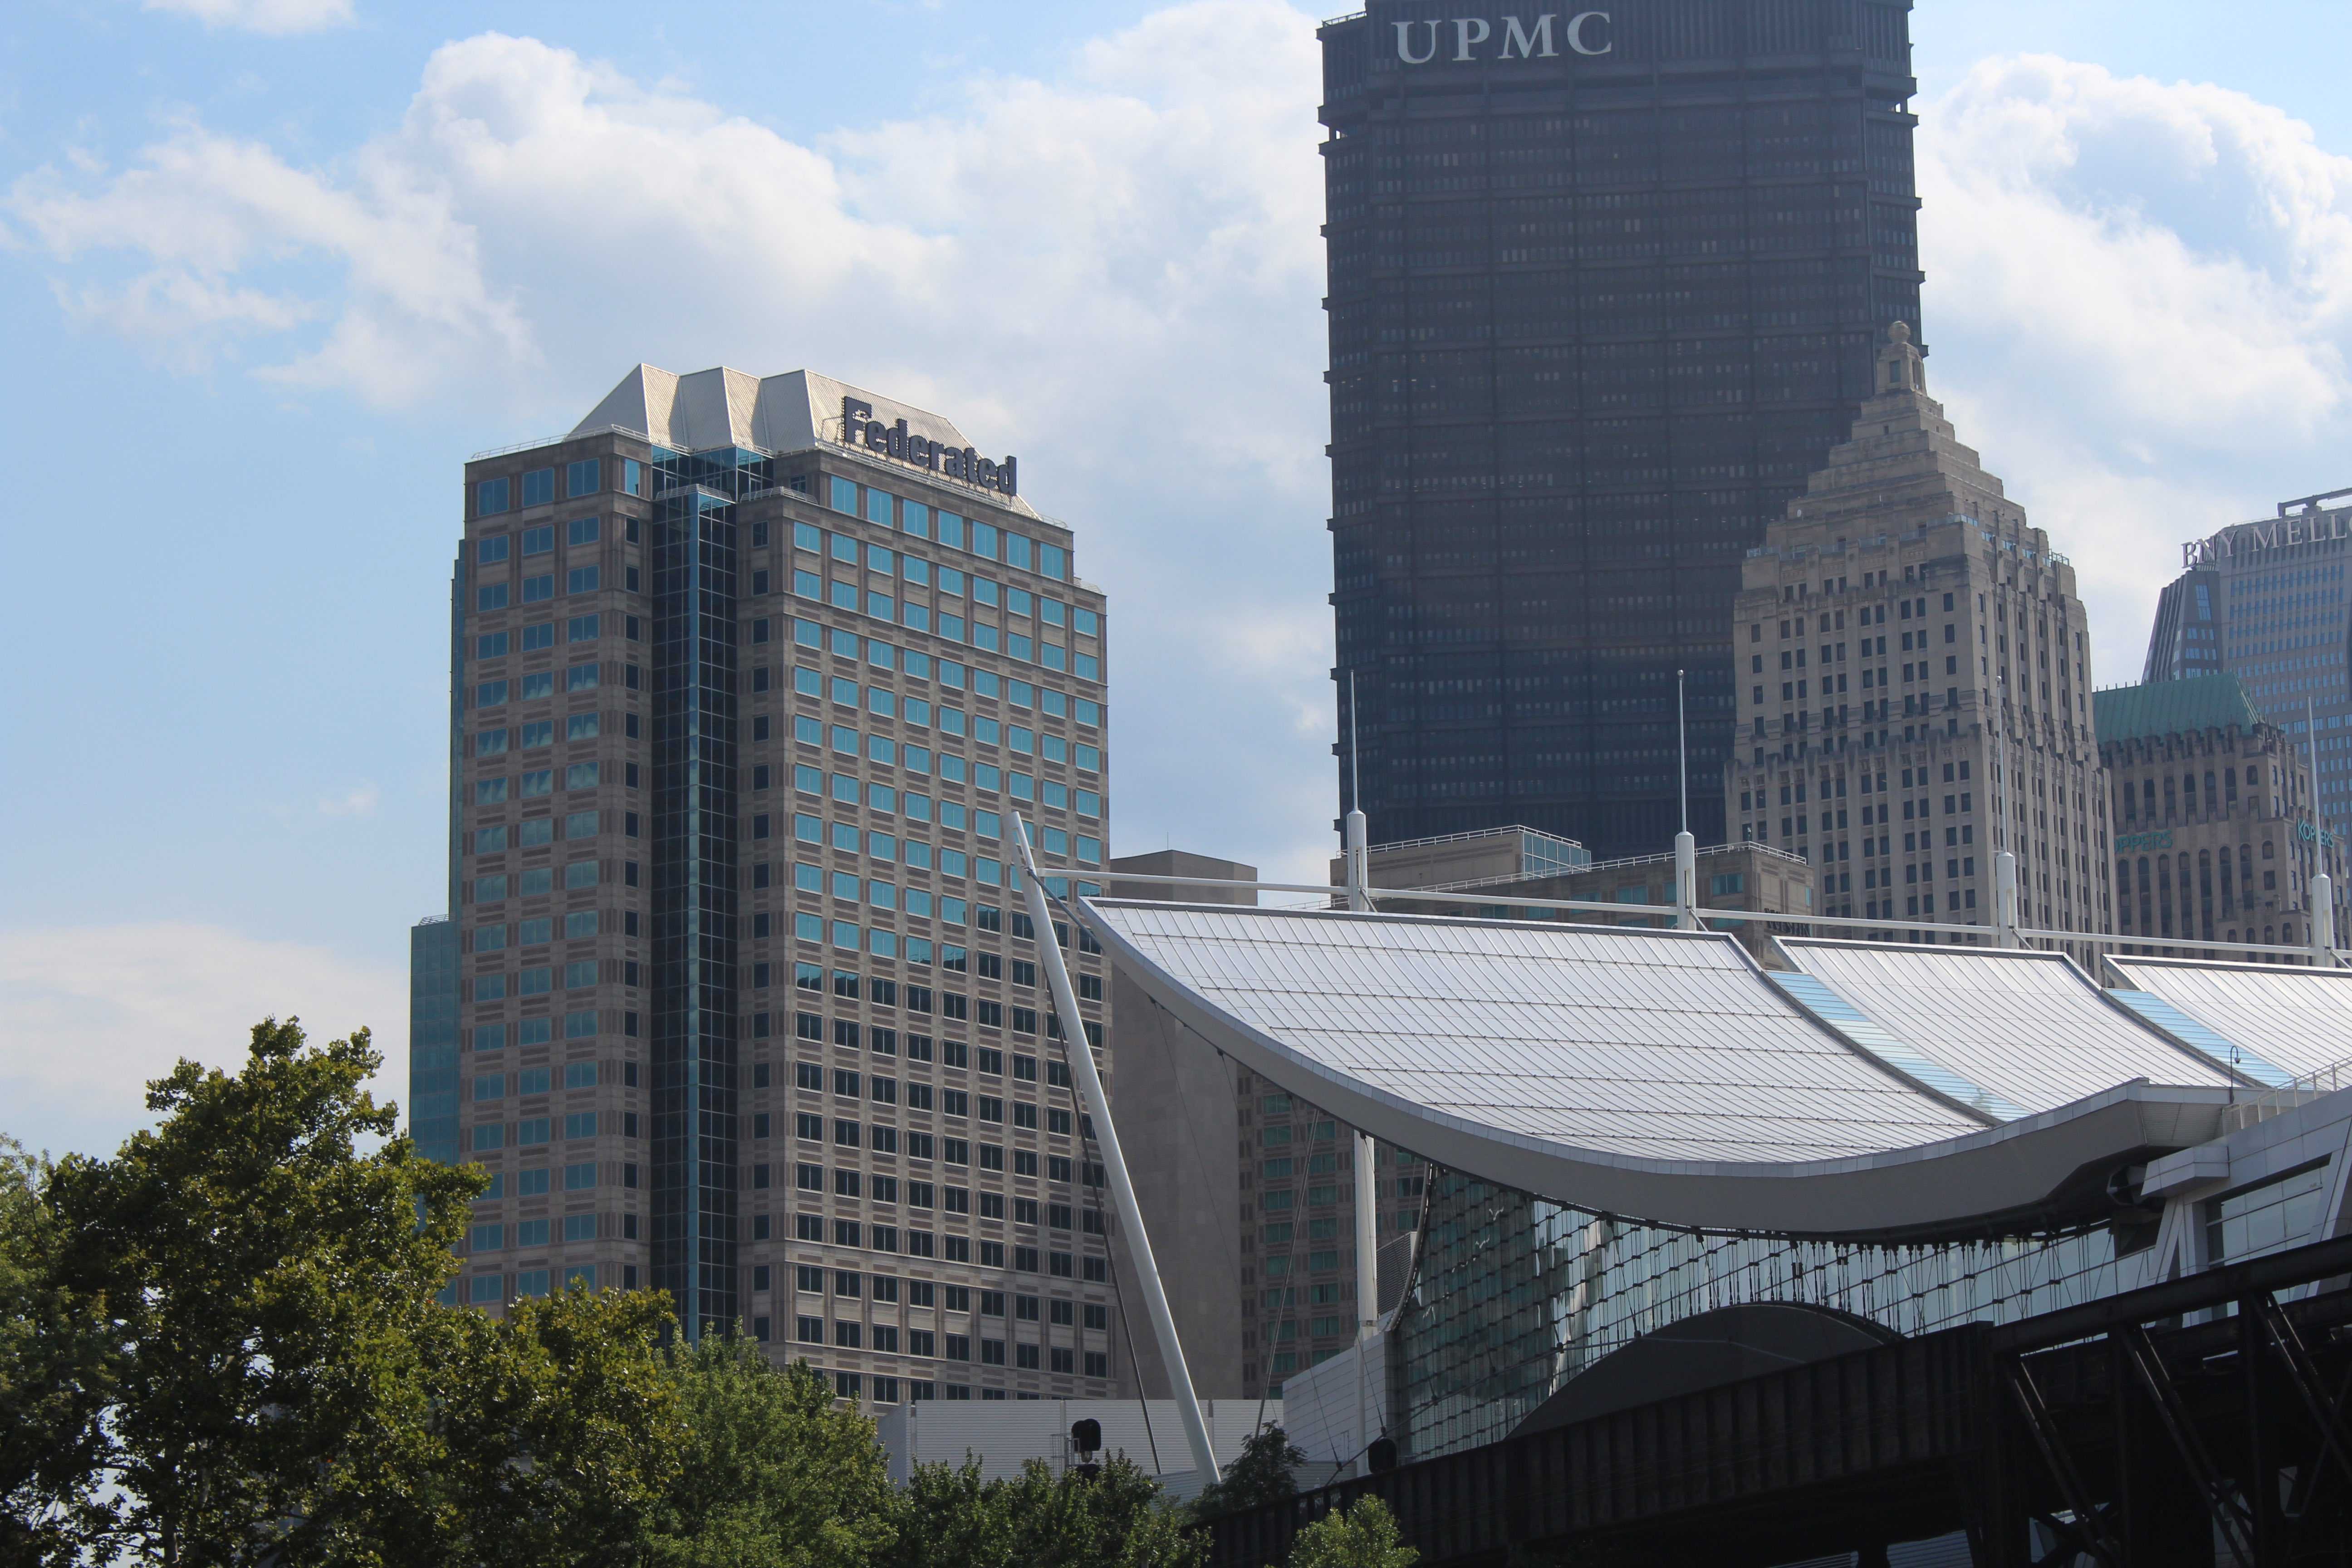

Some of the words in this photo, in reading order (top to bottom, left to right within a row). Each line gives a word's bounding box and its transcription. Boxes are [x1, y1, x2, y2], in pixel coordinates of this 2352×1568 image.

[1391, 11, 1612, 64] UPMC
[843, 396, 1017, 496] Federated
[2181, 529, 2239, 569] BNY
[2251, 513, 2352, 552] MELL
[2297, 818, 2334, 848] KOPERS
